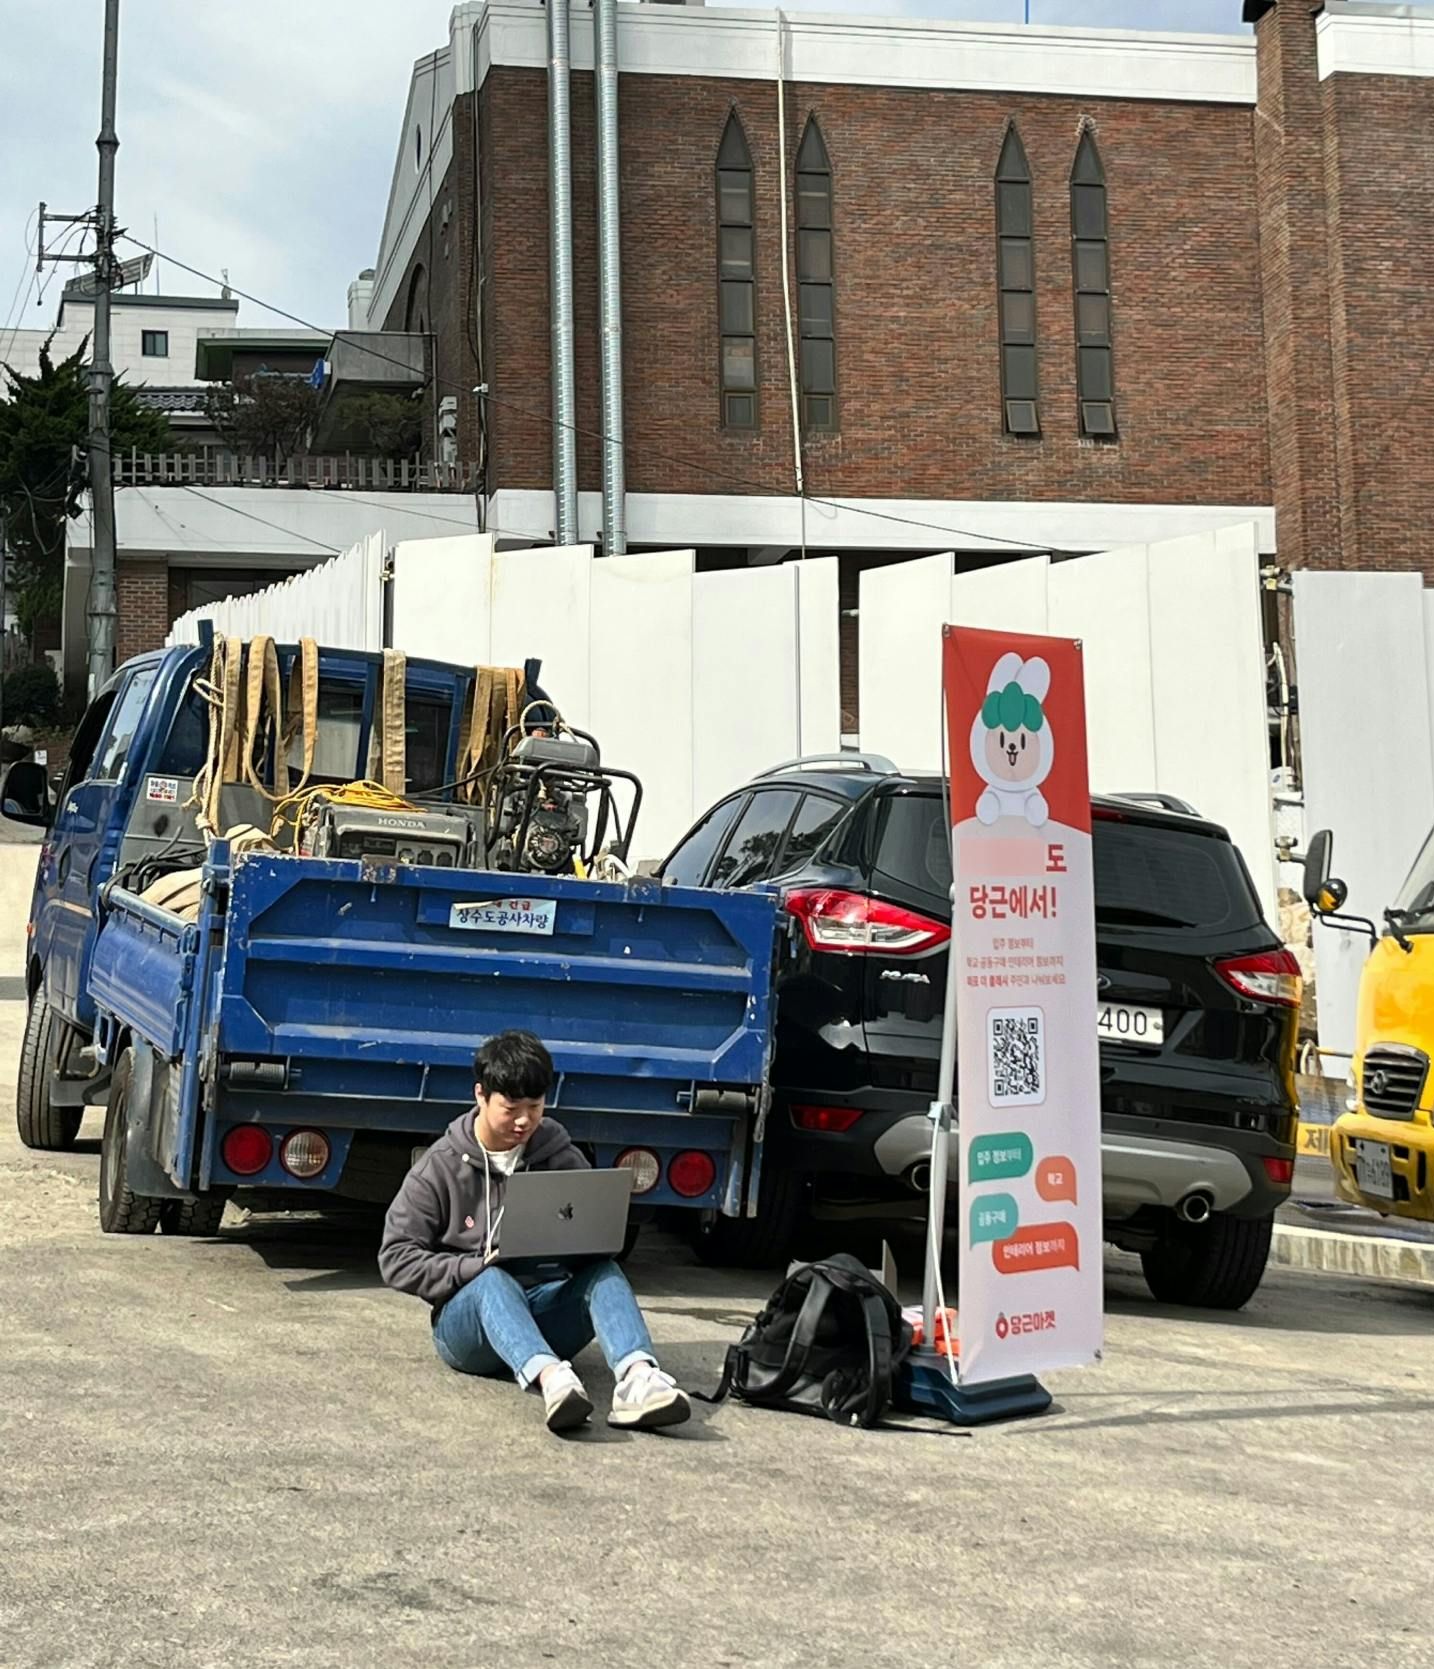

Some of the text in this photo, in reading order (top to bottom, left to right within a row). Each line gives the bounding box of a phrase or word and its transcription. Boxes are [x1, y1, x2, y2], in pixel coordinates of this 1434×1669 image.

[378, 817, 426, 830] HONDA
[969, 885, 1057, 919] 당근에서!
[457, 908, 549, 929] 상수도공사차량
[1098, 1006, 1147, 1036] 400
[1304, 1127, 1330, 1155] 제
[1010, 1311, 1056, 1336] 당근마켓
